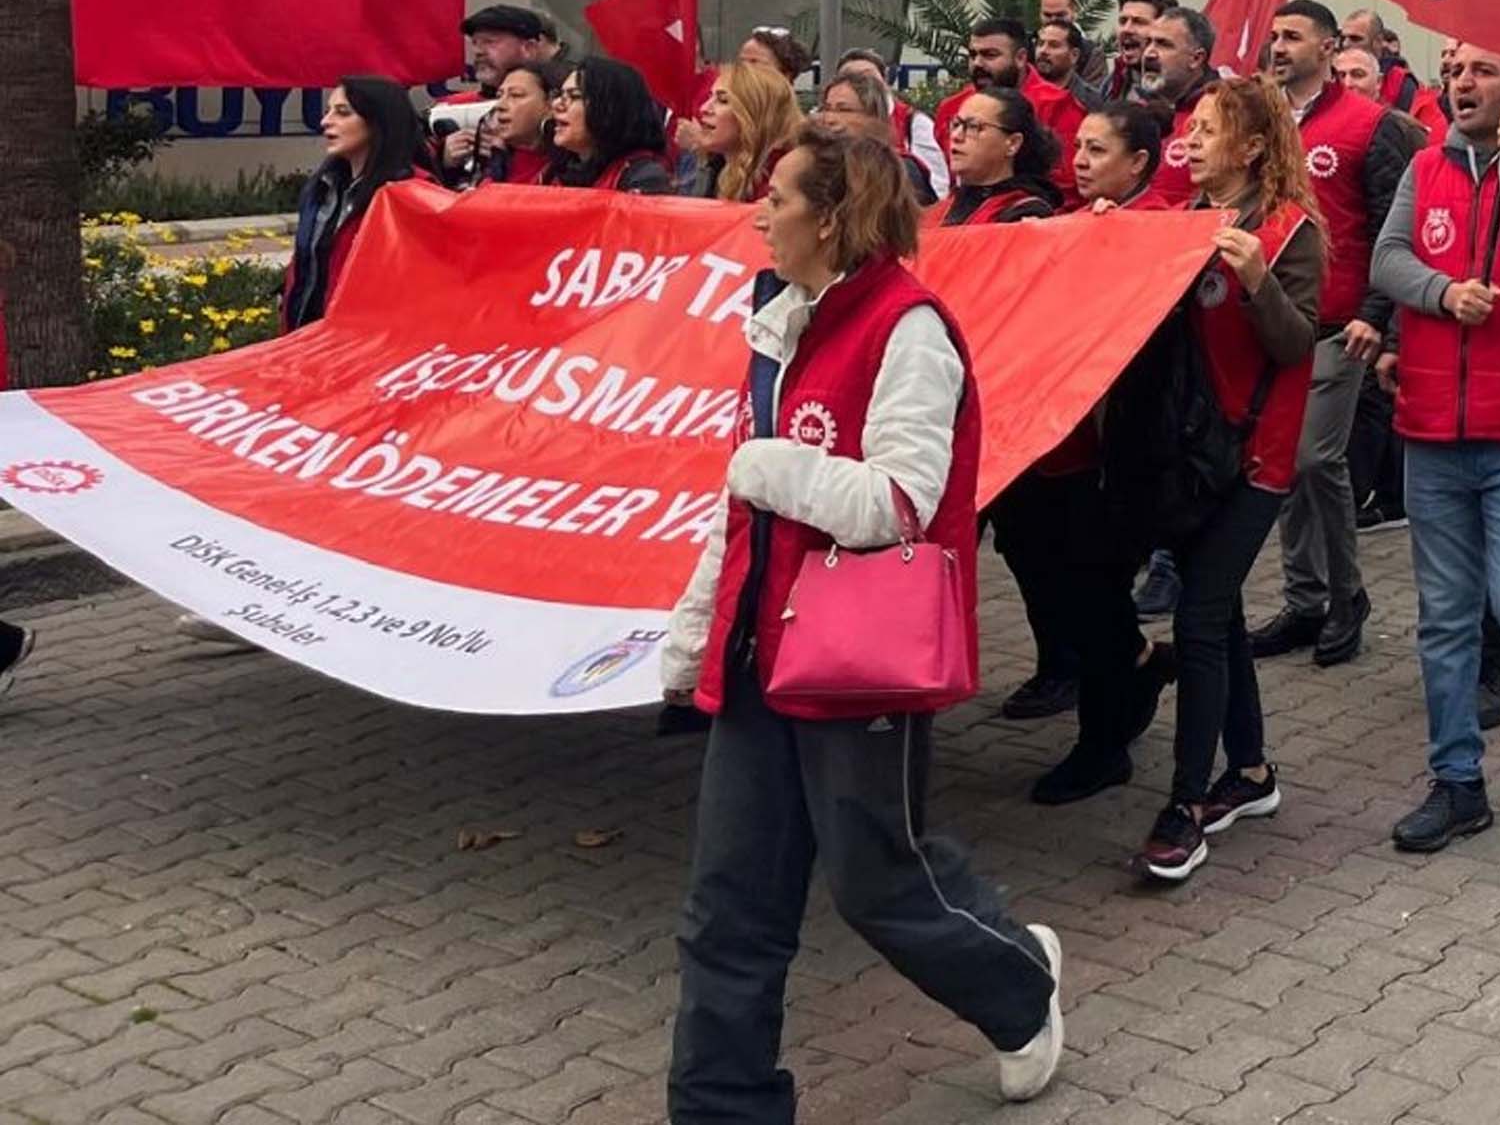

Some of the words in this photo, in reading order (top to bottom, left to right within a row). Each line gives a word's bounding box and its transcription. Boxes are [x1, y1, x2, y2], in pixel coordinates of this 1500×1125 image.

[131, 378, 356, 480] BİRİKEN
[329, 429, 660, 537] ÖDEMELER
[170, 534, 234, 566] DİSK
[312, 593, 379, 625] 1,2,3
[372, 610, 407, 634] ve
[401, 615, 425, 638] 9
[418, 620, 497, 655] No'lu
[222, 602, 328, 647] Şubeler
